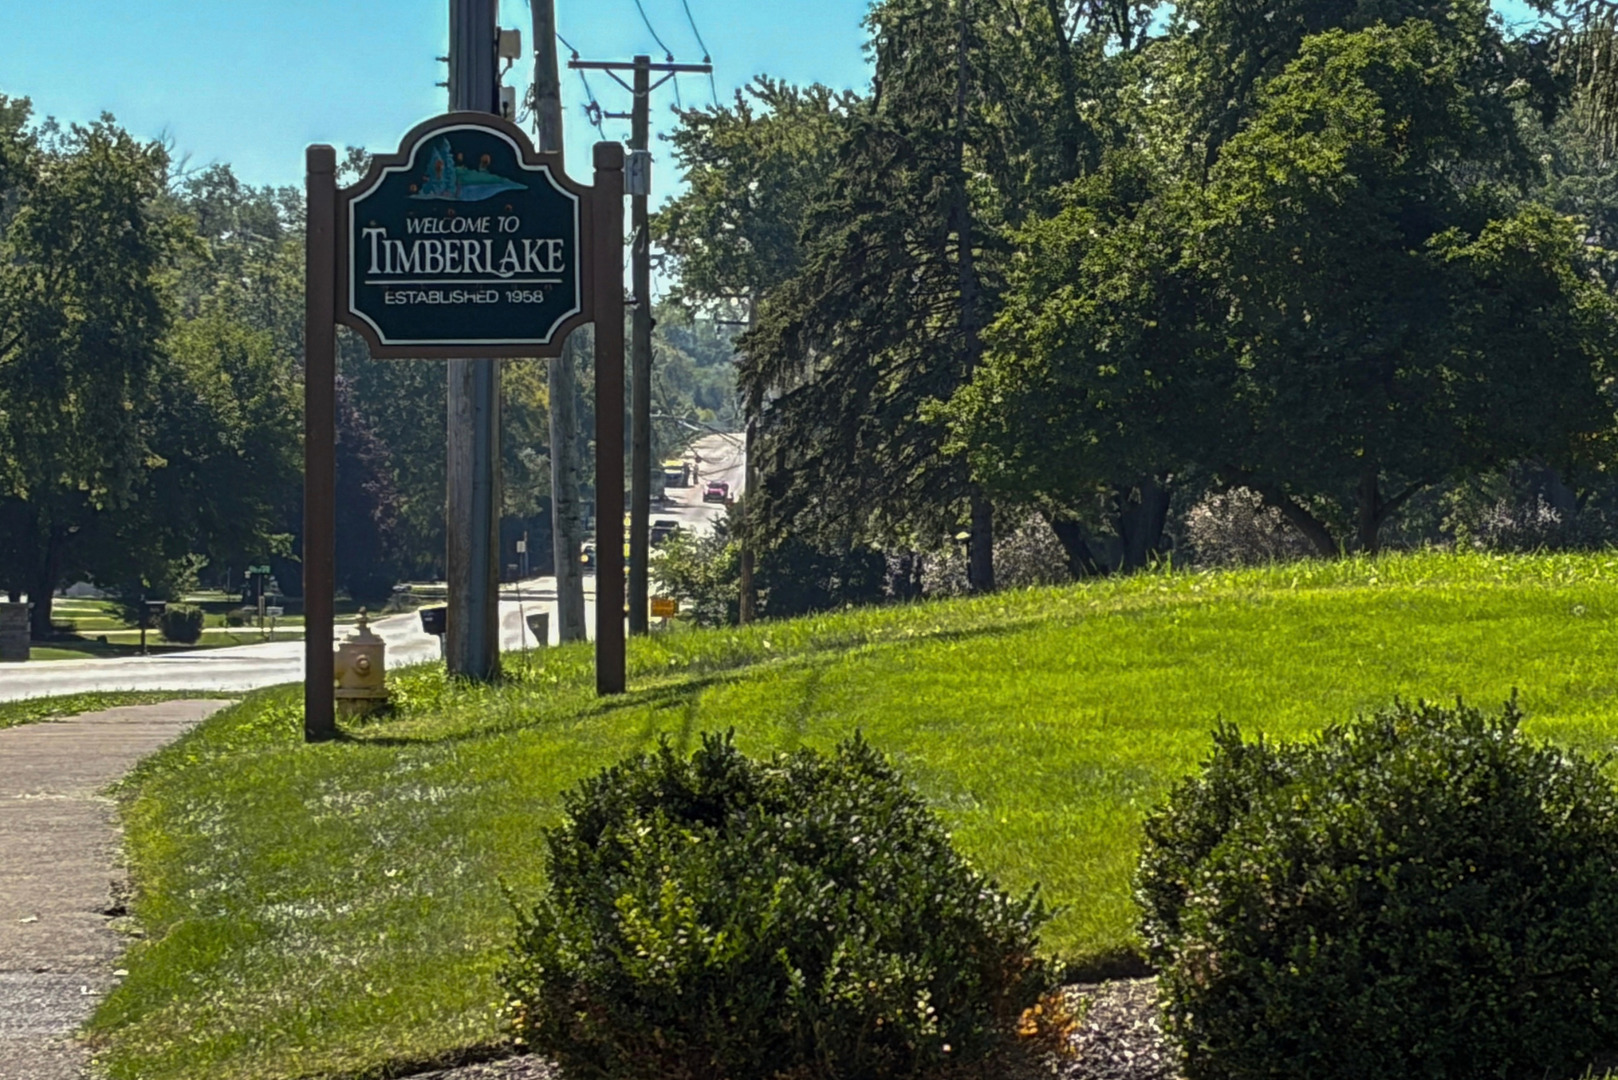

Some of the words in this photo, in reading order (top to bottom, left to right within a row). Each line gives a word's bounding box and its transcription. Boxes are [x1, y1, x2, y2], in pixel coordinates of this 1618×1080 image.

[406, 217, 490, 233] WELCOME
[498, 216, 520, 233] TO
[361, 227, 565, 278] TIMBERLAKE
[384, 290, 499, 304] ESTABLISHED
[505, 290, 544, 303] 1958
